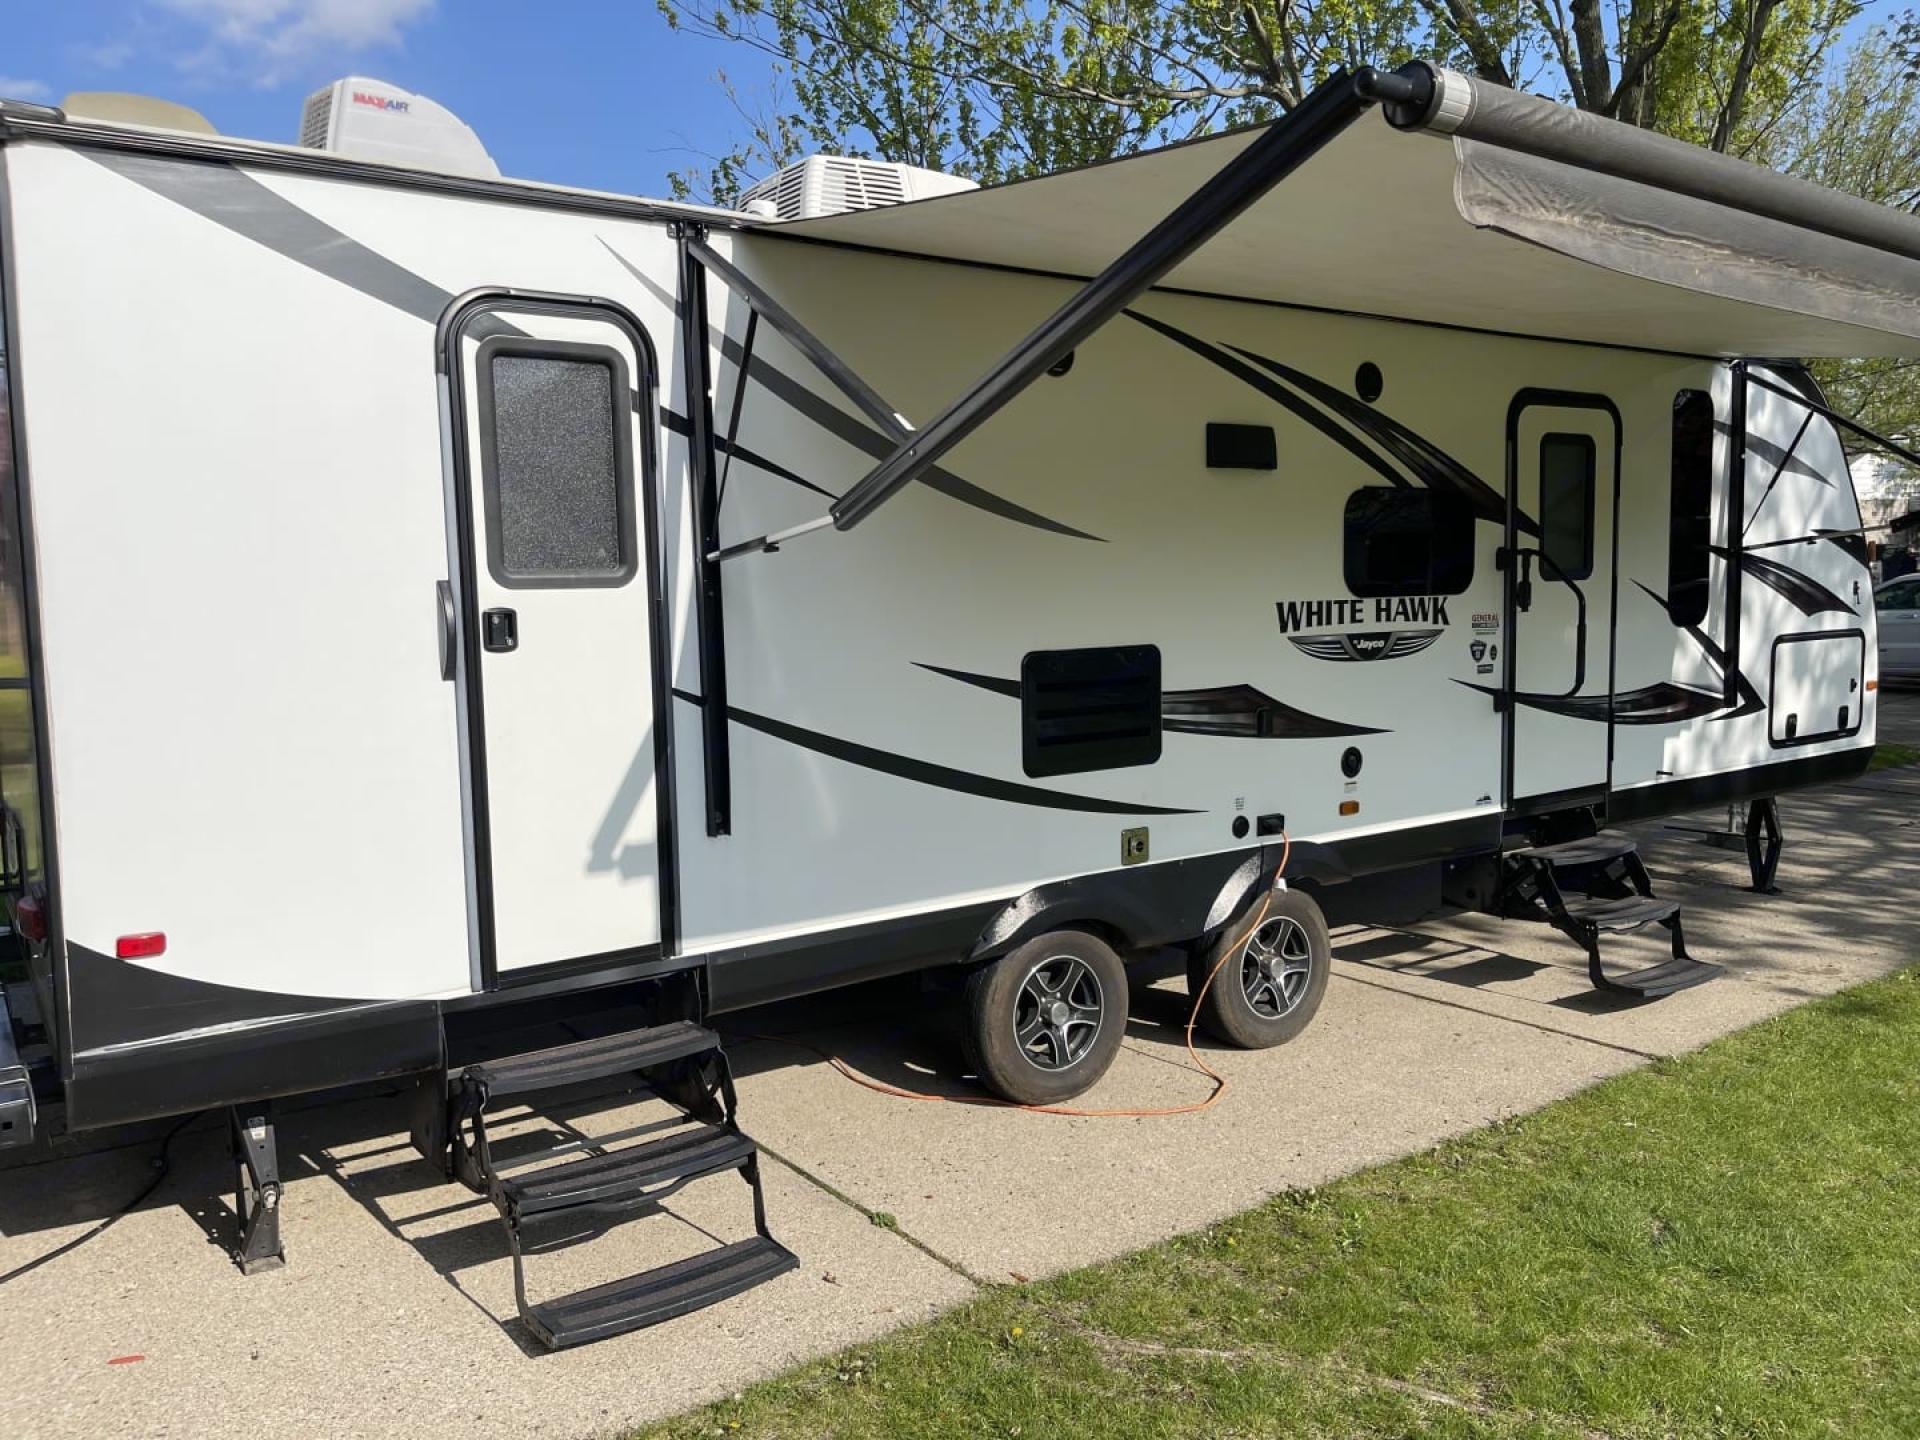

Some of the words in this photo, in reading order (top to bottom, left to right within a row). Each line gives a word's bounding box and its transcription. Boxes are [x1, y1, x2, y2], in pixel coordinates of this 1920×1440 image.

[1276, 599, 1364, 633] WHITE
[1375, 597, 1450, 626] HAWK
[1356, 639, 1385, 651] Jayco
